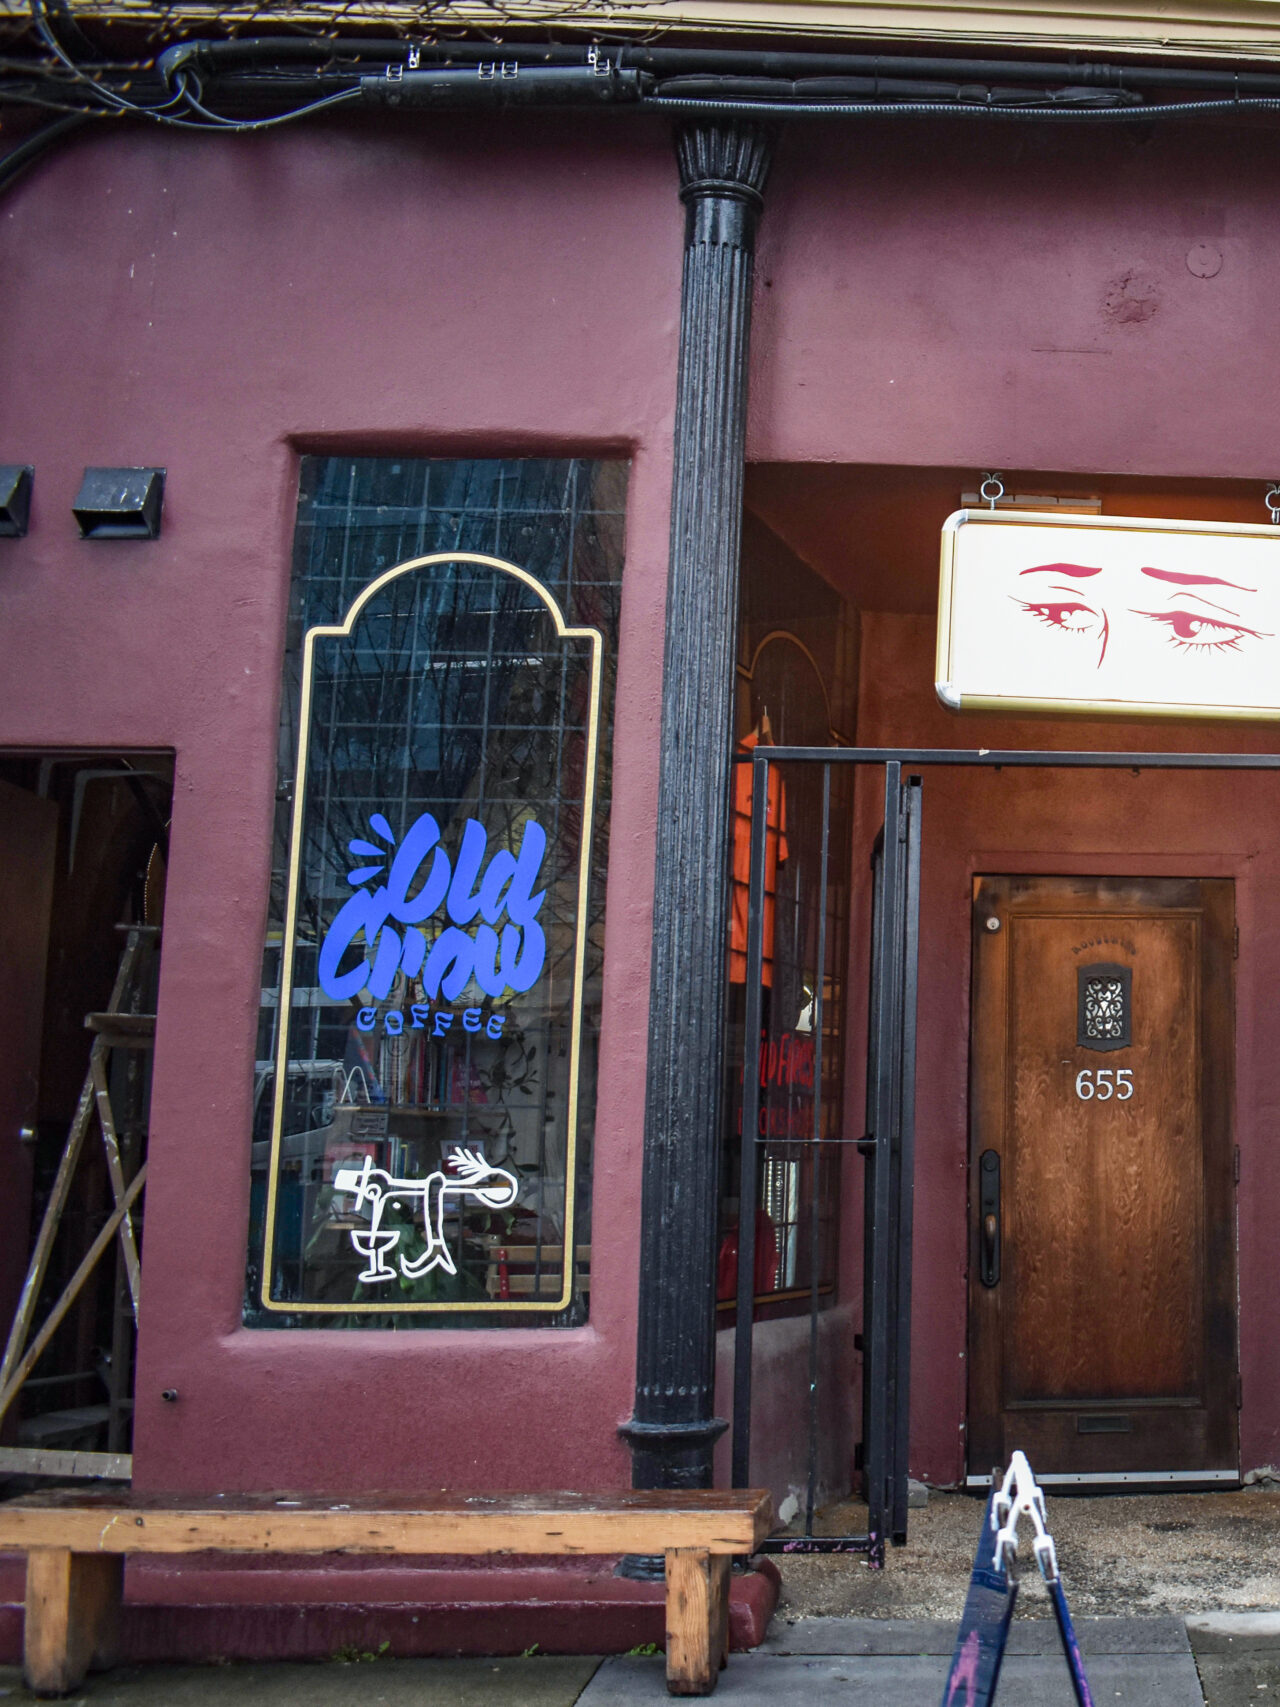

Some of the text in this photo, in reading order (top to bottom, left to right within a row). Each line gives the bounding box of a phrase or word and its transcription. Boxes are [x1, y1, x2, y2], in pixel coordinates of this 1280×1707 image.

[386, 813, 547, 925] Old
[318, 886, 547, 1003] Crow
[357, 1004, 506, 1040] COFFEE
[1075, 1069, 1134, 1101] 655
